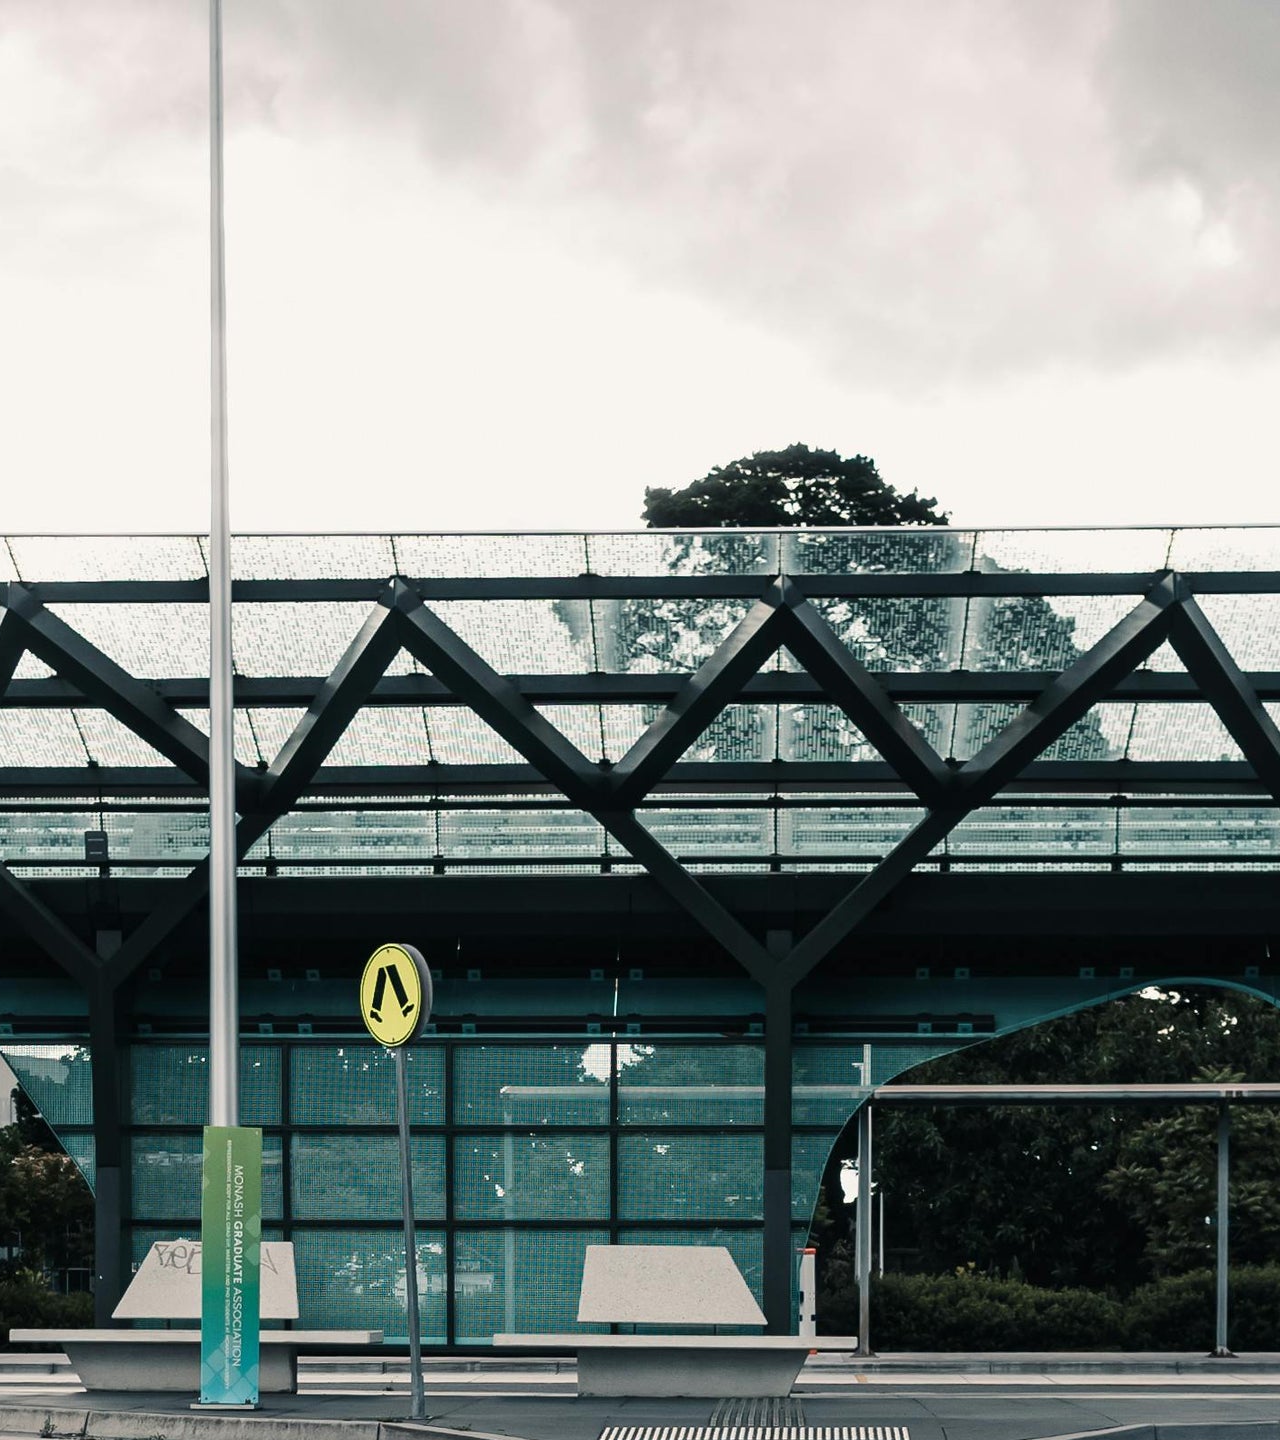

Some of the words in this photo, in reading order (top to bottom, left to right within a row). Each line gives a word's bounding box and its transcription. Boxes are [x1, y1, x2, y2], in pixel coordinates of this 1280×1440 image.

[234, 1165, 244, 1217] MONASH
[233, 1221, 243, 1284] GRADUATE
[232, 1287, 242, 1367] ASSOCIATION
